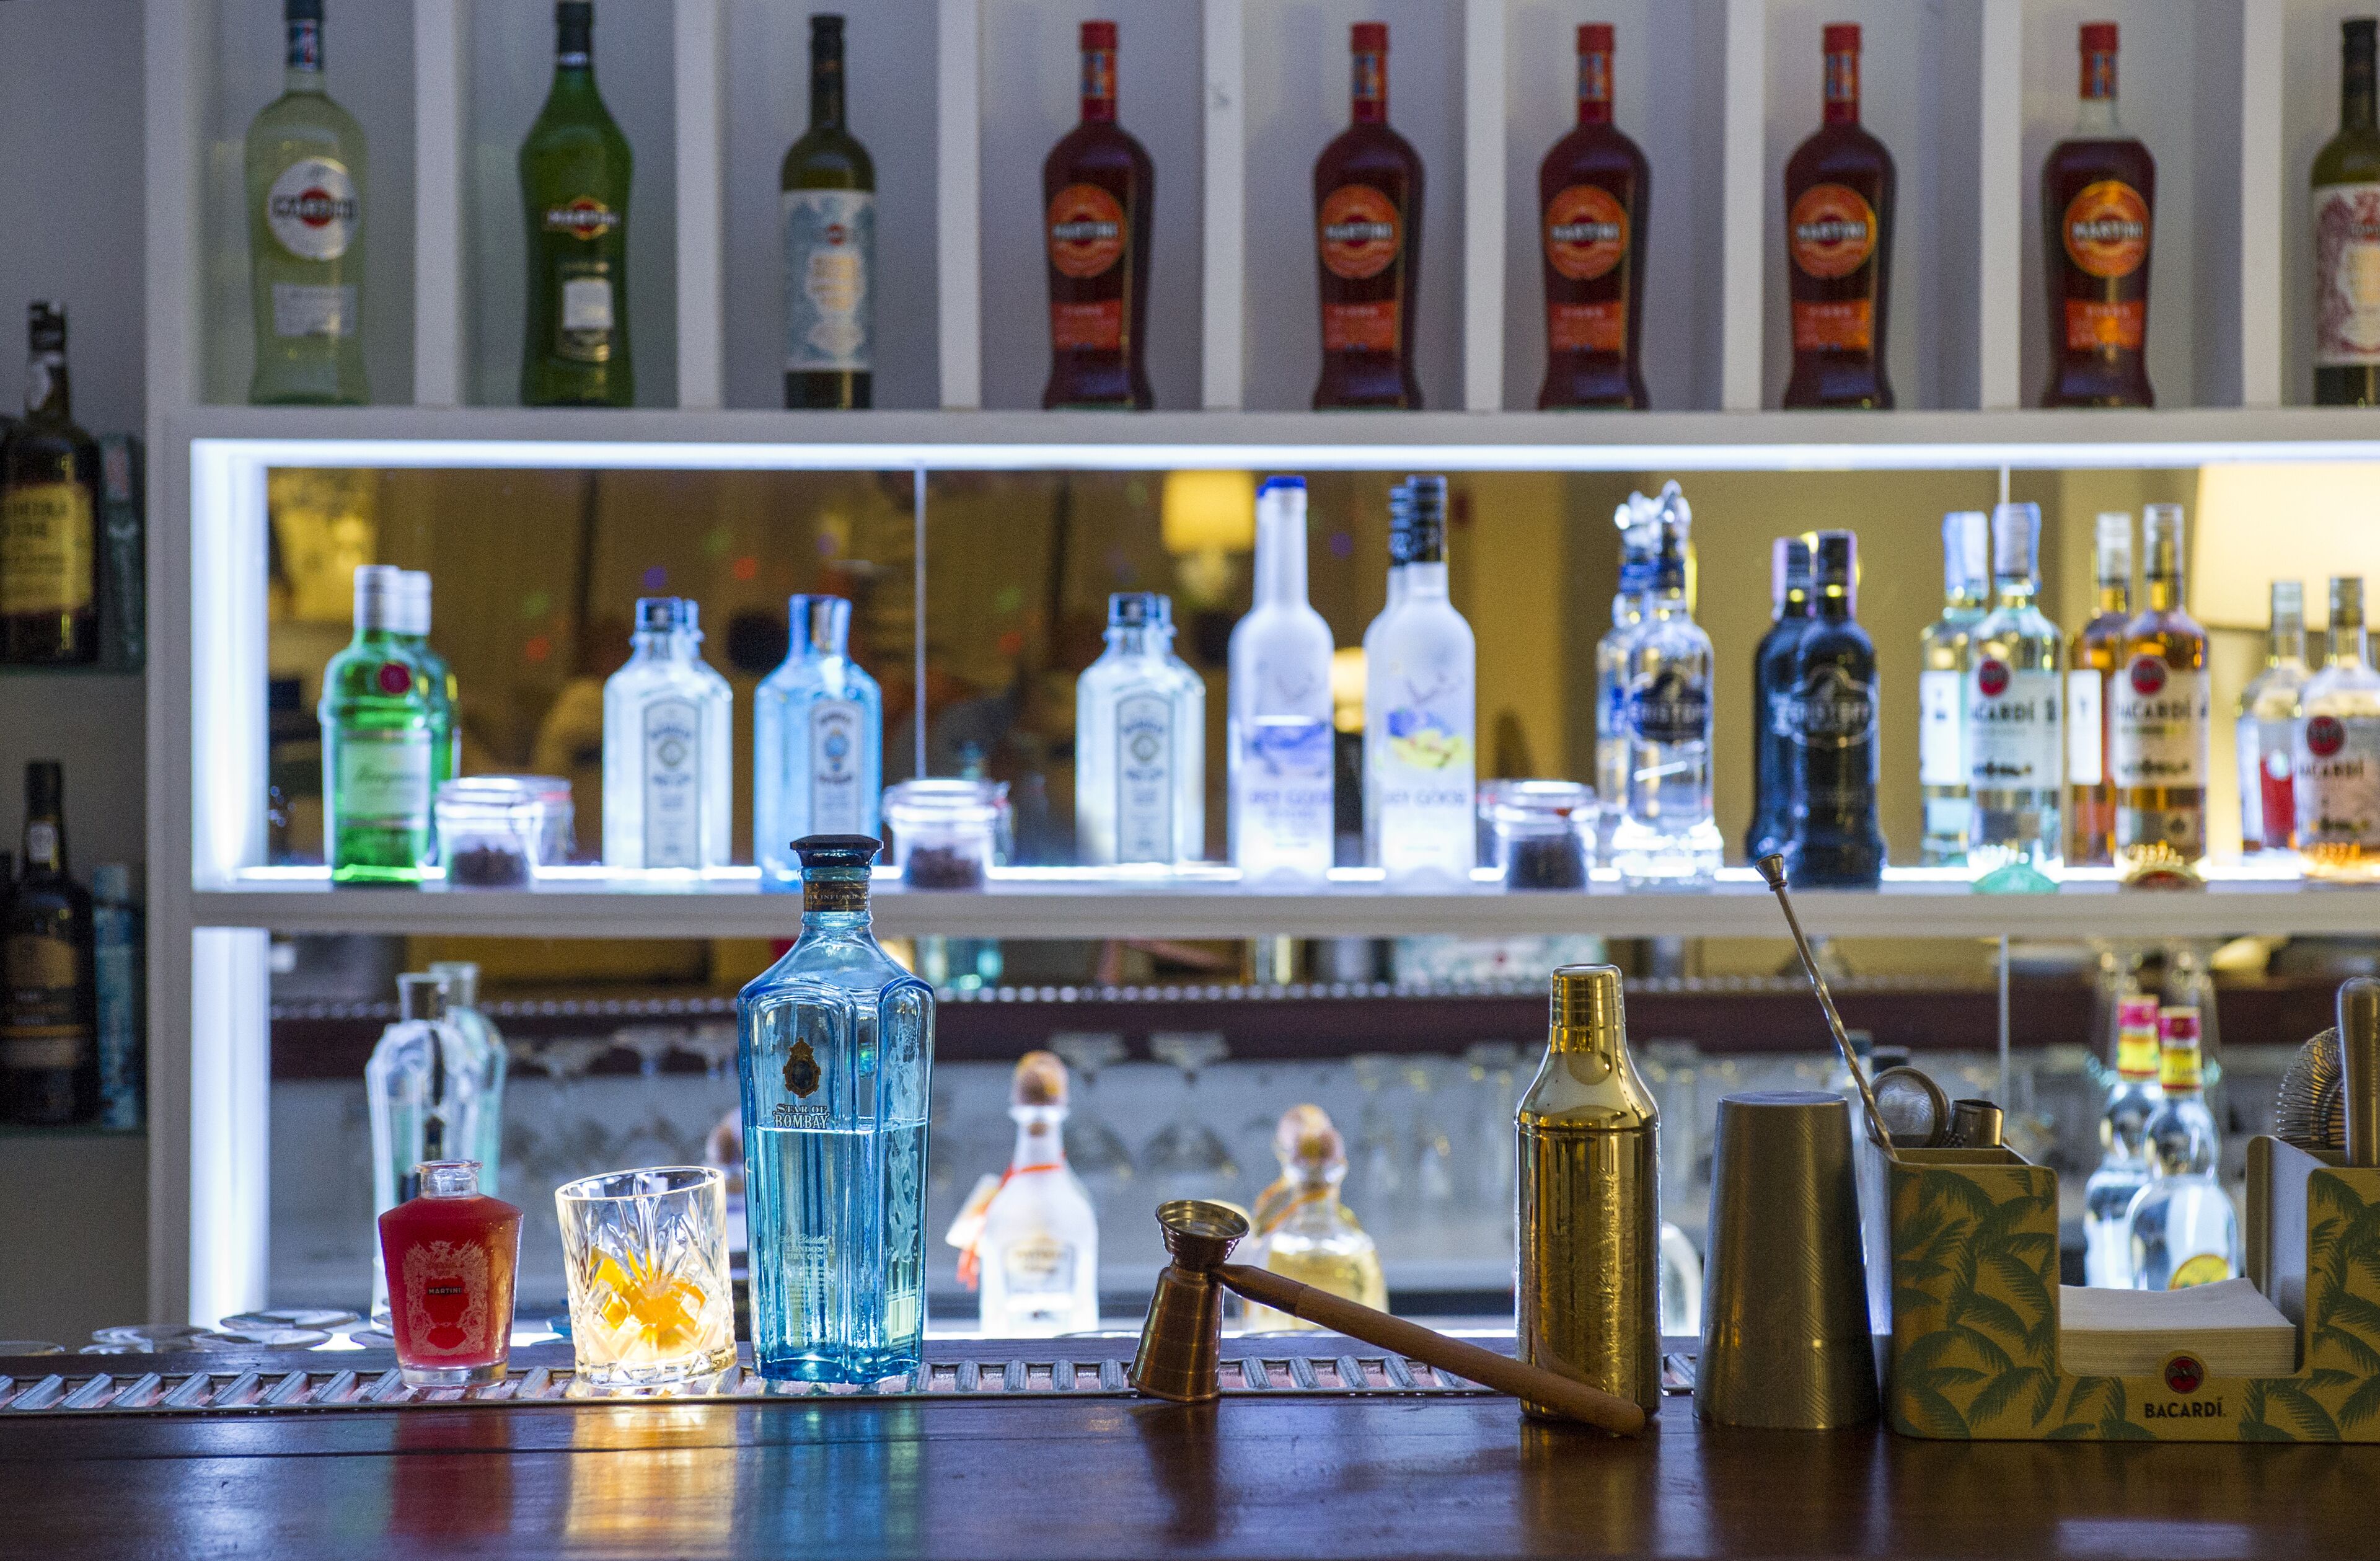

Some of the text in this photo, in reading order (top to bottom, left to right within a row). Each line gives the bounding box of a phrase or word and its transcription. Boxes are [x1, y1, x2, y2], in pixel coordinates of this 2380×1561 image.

[2071, 221, 2143, 239] MARTINI
[772, 1111, 831, 1129] BOMBAY
[2144, 1395, 2223, 1418] BACARDÍ
